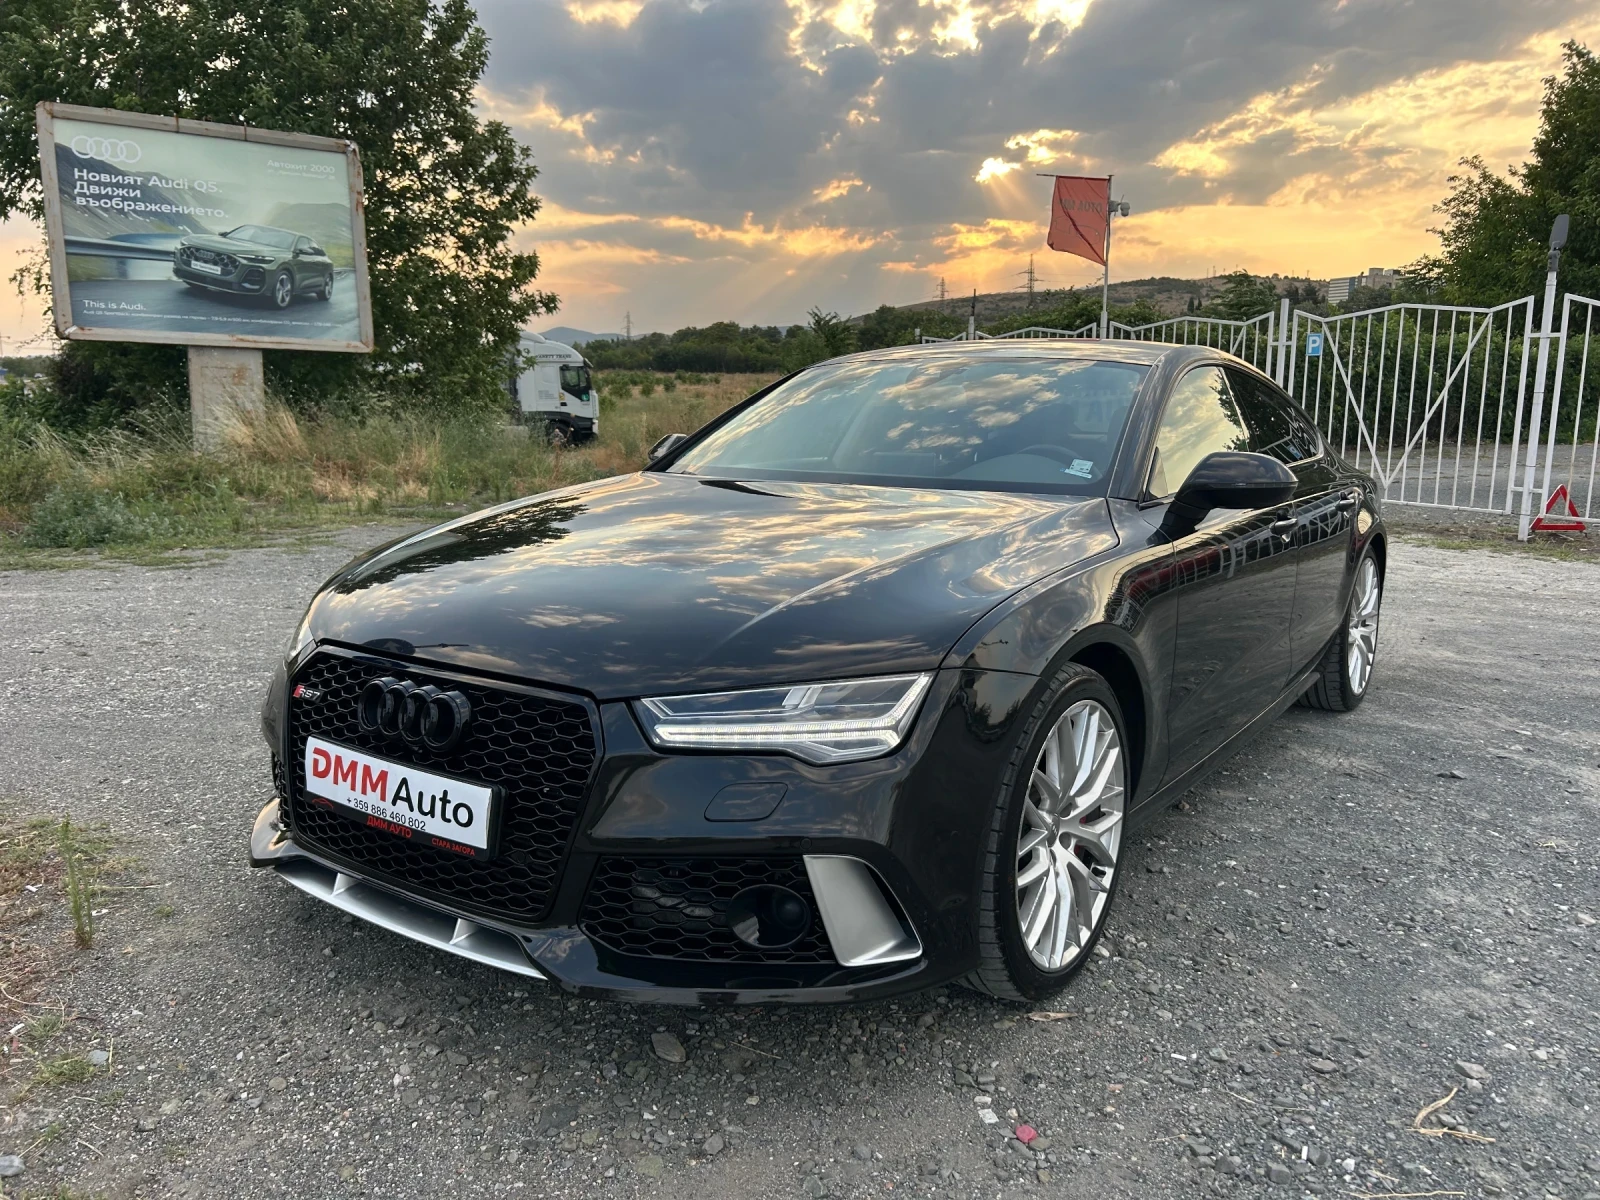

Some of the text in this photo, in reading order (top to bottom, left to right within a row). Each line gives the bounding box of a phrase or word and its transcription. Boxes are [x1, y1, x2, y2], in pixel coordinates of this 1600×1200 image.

[267, 159, 336, 174] Автохит 2000
[73, 167, 223, 194] Новият Audi Q5.
[74, 181, 142, 199] Движи
[75, 194, 230, 219] въображението.
[82, 299, 146, 311] This is Audi.
[1308, 336, 1320, 354] P
[292, 684, 320, 701] RS7
[312, 747, 474, 828] DMM Auto
[353, 798, 369, 812] 359
[370, 804, 388, 818] 886
[389, 811, 407, 825] 460
[408, 817, 426, 832] 802
[366, 815, 412, 839] ДММ АУТО
[431, 837, 475, 857] СТАРА ЗАГОРА
